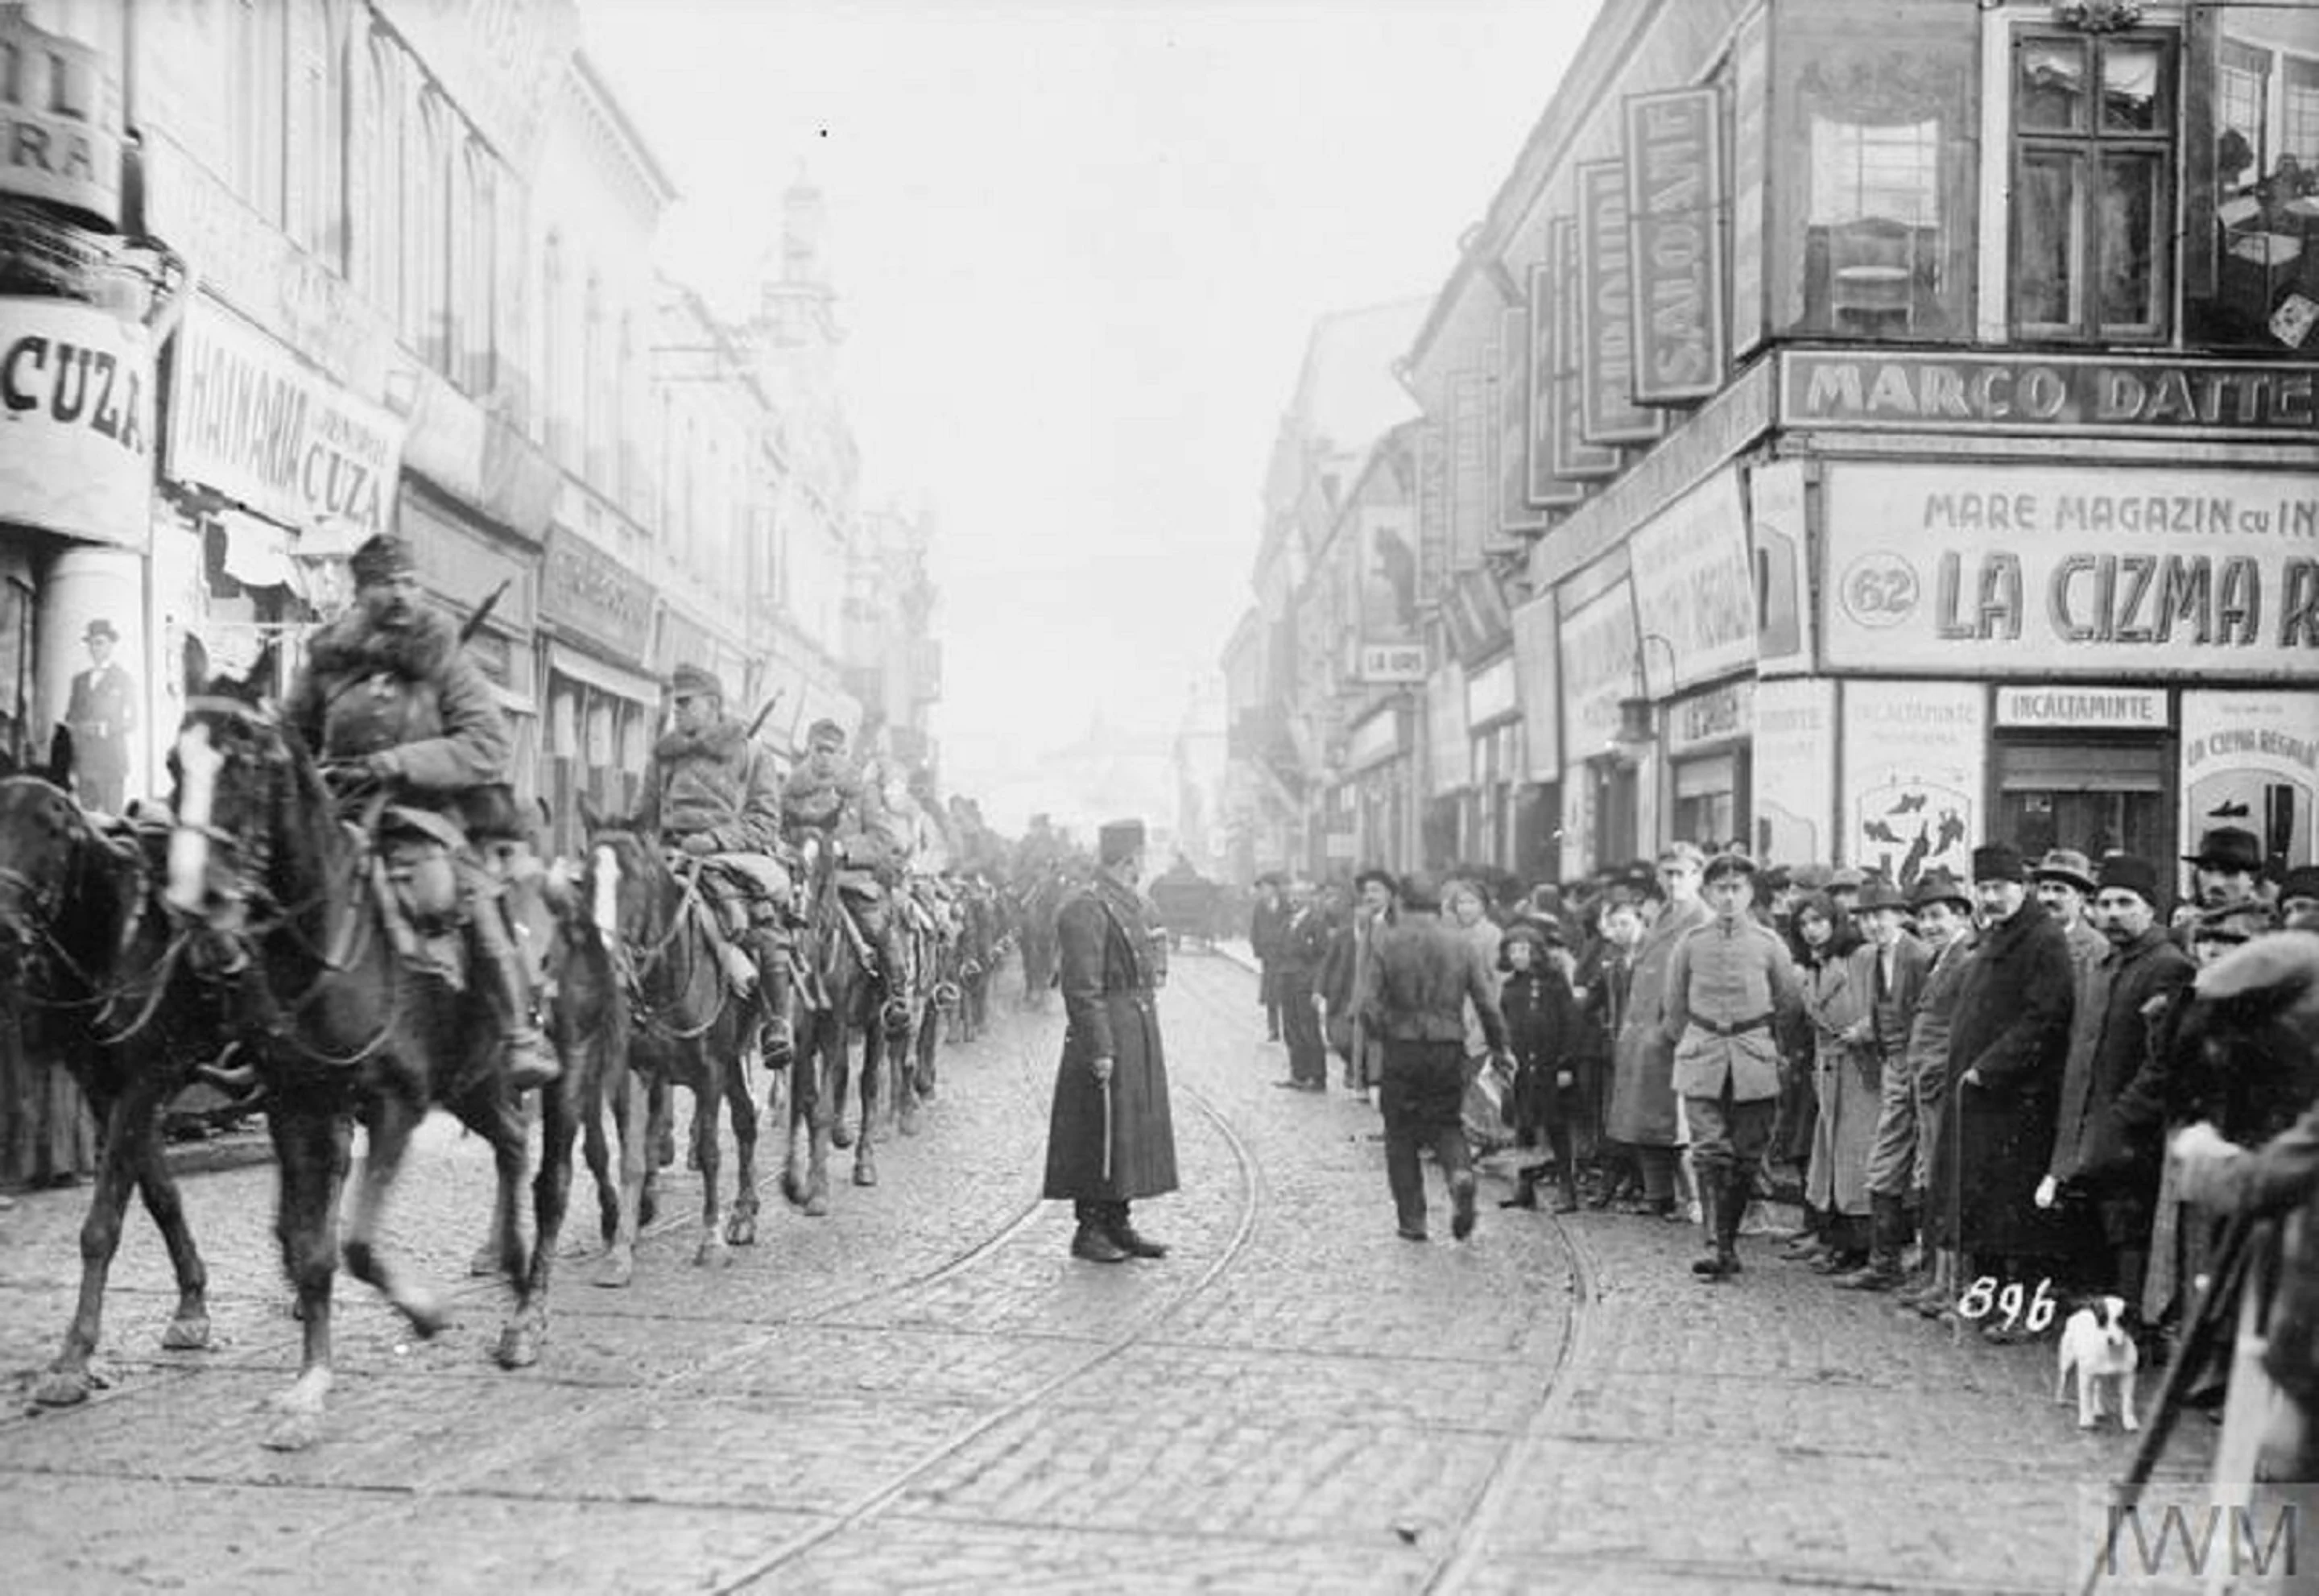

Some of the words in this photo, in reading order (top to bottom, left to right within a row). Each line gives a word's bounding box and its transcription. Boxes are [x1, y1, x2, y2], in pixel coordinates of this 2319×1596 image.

[1646, 101, 1709, 382] SALOANE
[2, 335, 145, 455] CUZA
[1807, 364, 2067, 418] MARCO
[304, 441, 381, 529] CUZA
[1924, 491, 2037, 531] MARE
[2054, 496, 2233, 535] MAGAZIN
[1853, 567, 1915, 614] 62
[1935, 549, 2023, 641] LA
[2045, 553, 2263, 646] CIZMA
